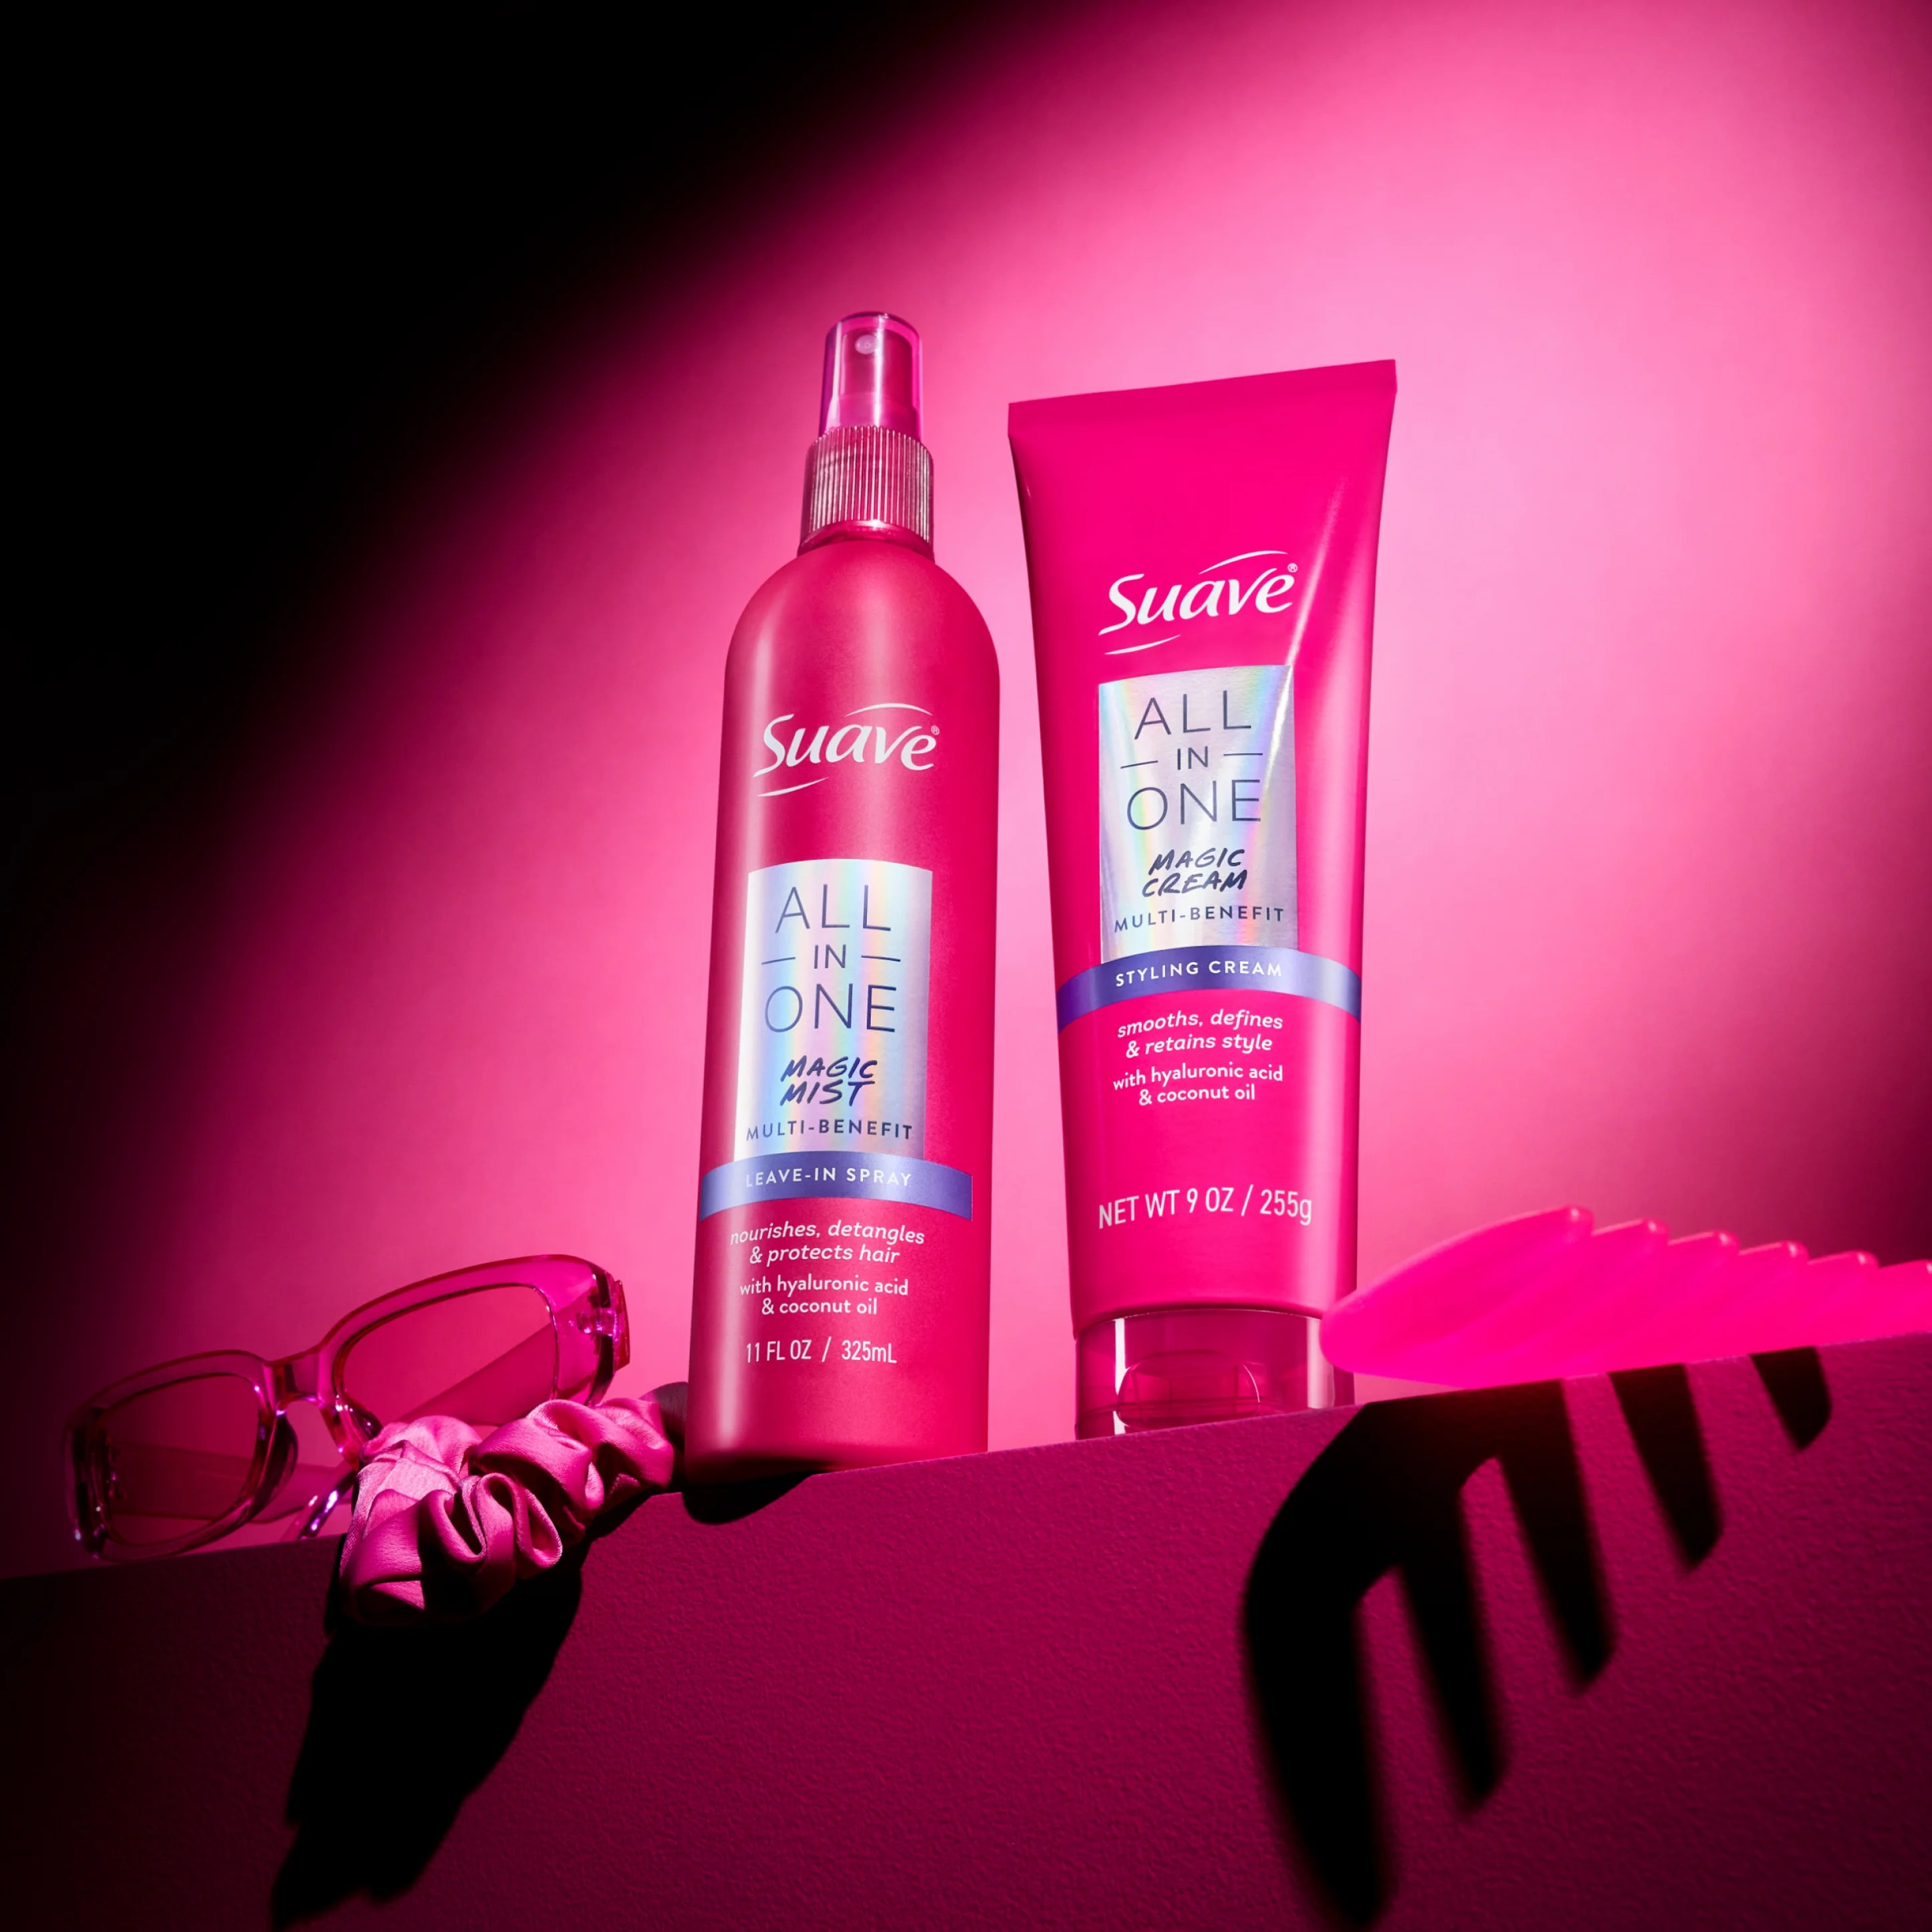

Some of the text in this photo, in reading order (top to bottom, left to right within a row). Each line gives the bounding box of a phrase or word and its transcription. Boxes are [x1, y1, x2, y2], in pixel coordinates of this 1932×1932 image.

[1098, 568, 1295, 636] Suave
[1134, 690, 1251, 739] ALL
[753, 713, 937, 777] Suave
[1177, 746, 1208, 770] IN
[1127, 779, 1261, 830] ONE
[1149, 848, 1245, 875] MAGIC
[1142, 870, 1247, 897] CREAM
[775, 884, 891, 933] ALL
[1114, 906, 1284, 933] MULTI-BENEFIT
[814, 944, 846, 969] IN
[1116, 961, 1282, 987] STYLING CREAM
[765, 983, 896, 1033] ONE
[1117, 1009, 1283, 1038] smooths, defines
[1126, 1034, 1272, 1058] & retains style
[780, 1055, 878, 1082] MAGIC
[1113, 1062, 1283, 1090] with hyaluronic acid
[779, 1079, 875, 1106] MIST
[1139, 1084, 1255, 1106] & coconut oil
[746, 1118, 913, 1140] MULTI-BENEFIT
[746, 1167, 911, 1187] LEAVE-IN SPRAY
[1099, 1195, 1139, 1229] NET
[1145, 1190, 1180, 1219] WT
[1187, 1188, 1198, 1213] 9
[1205, 1187, 1234, 1212] OZ
[1260, 1189, 1312, 1226] 255g
[730, 1220, 925, 1245] nourishes, detangles
[749, 1244, 900, 1266] & protects hair
[740, 1274, 909, 1297] with hyaluronic acid
[761, 1298, 877, 1314] & coconut oil
[746, 1342, 759, 1363] 11
[767, 1341, 785, 1360] FL
[790, 1339, 812, 1360] OZ
[841, 1340, 897, 1363] 325mL
